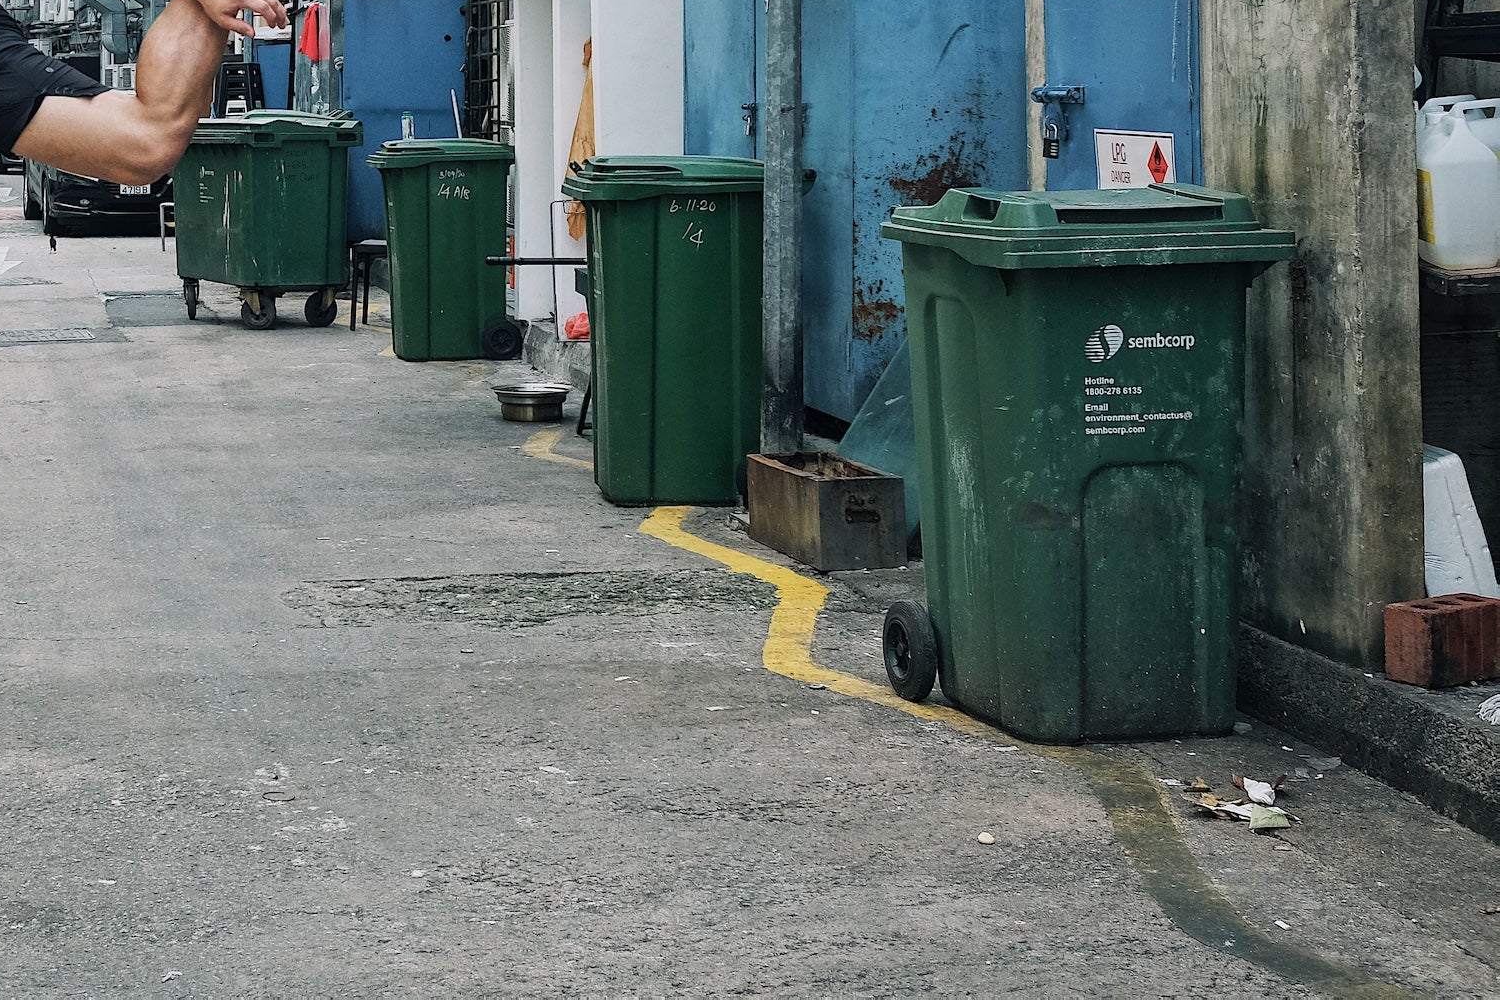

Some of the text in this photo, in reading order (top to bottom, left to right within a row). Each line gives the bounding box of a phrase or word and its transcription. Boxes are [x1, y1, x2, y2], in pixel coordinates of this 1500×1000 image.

[1111, 142, 1127, 162] LPG
[1128, 332, 1195, 351] sembcorp
[1084, 377, 1115, 386] Hotline
[1084, 386, 1143, 396] 1800-278 6135
[1084, 403, 1109, 412] Email
[1084, 410, 1193, 423] environment_contactus@
[1085, 425, 1146, 436] sembcorp.com
